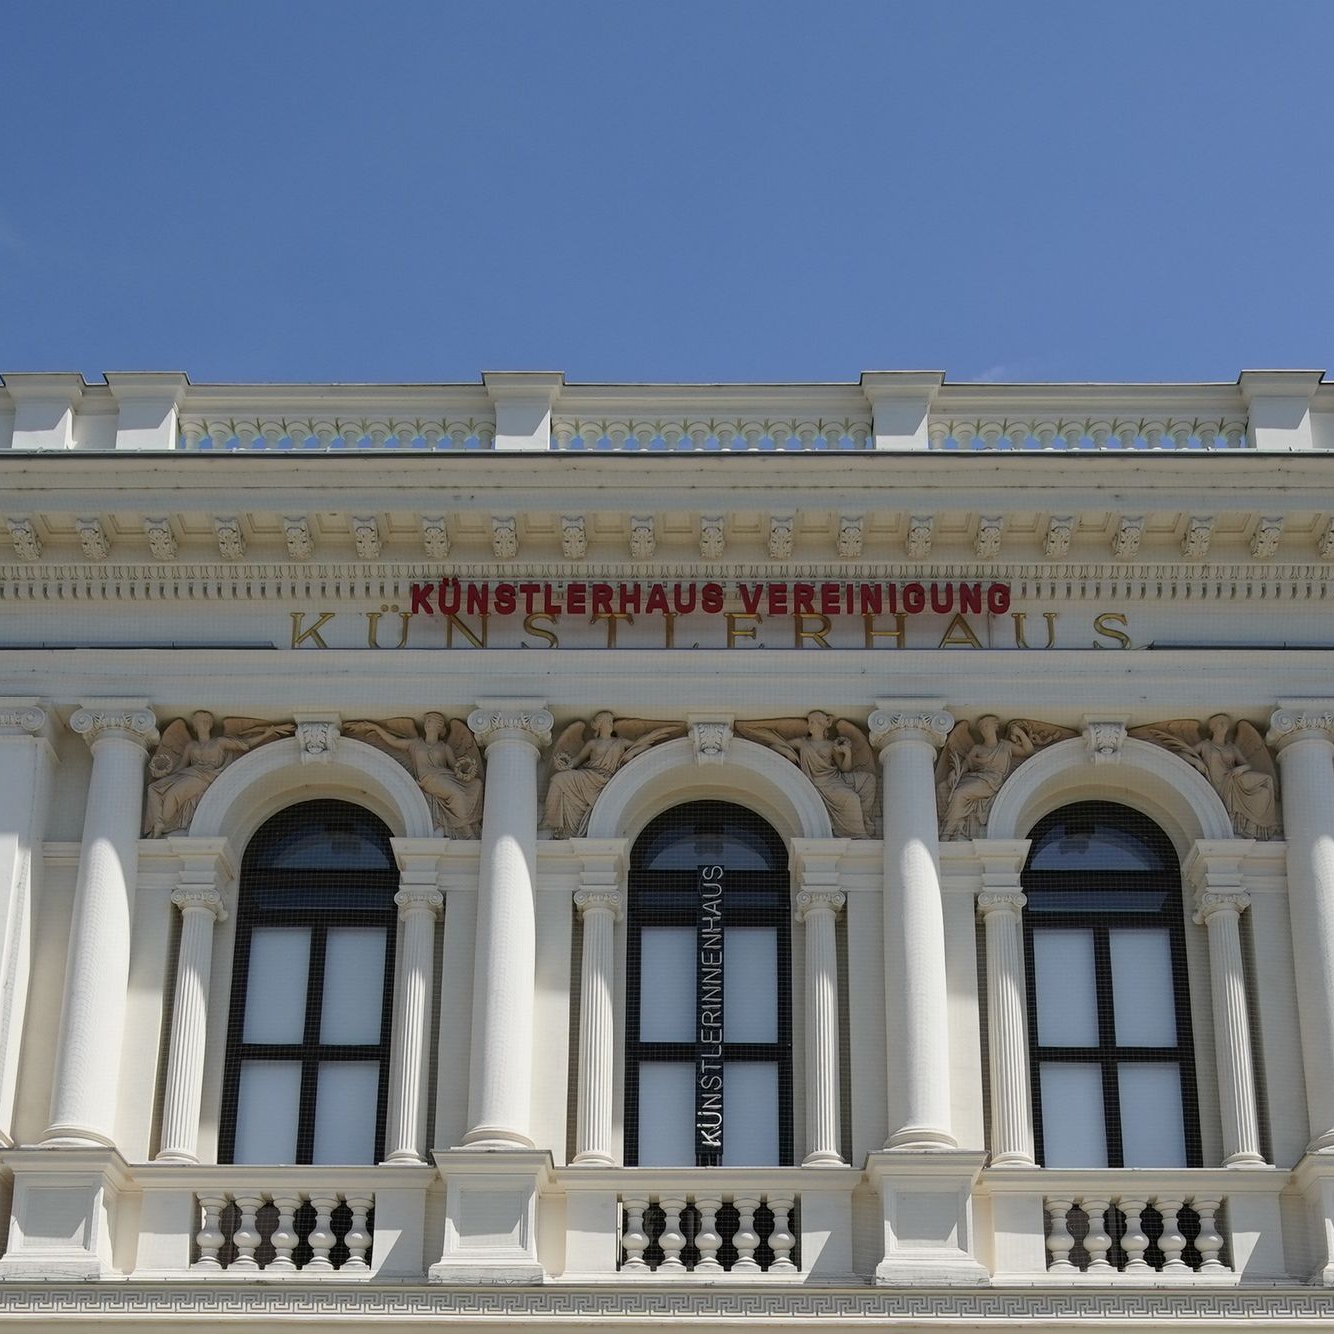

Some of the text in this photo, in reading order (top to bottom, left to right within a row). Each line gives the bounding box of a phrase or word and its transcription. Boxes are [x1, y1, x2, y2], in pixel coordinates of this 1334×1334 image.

[411, 577, 1011, 615] KÜNSTLERHAUS VEREINIGUNG
[290, 604, 1133, 649] KÜNSTLERHAUS
[696, 864, 724, 1147] KÜNSTLERINNENHAUS
